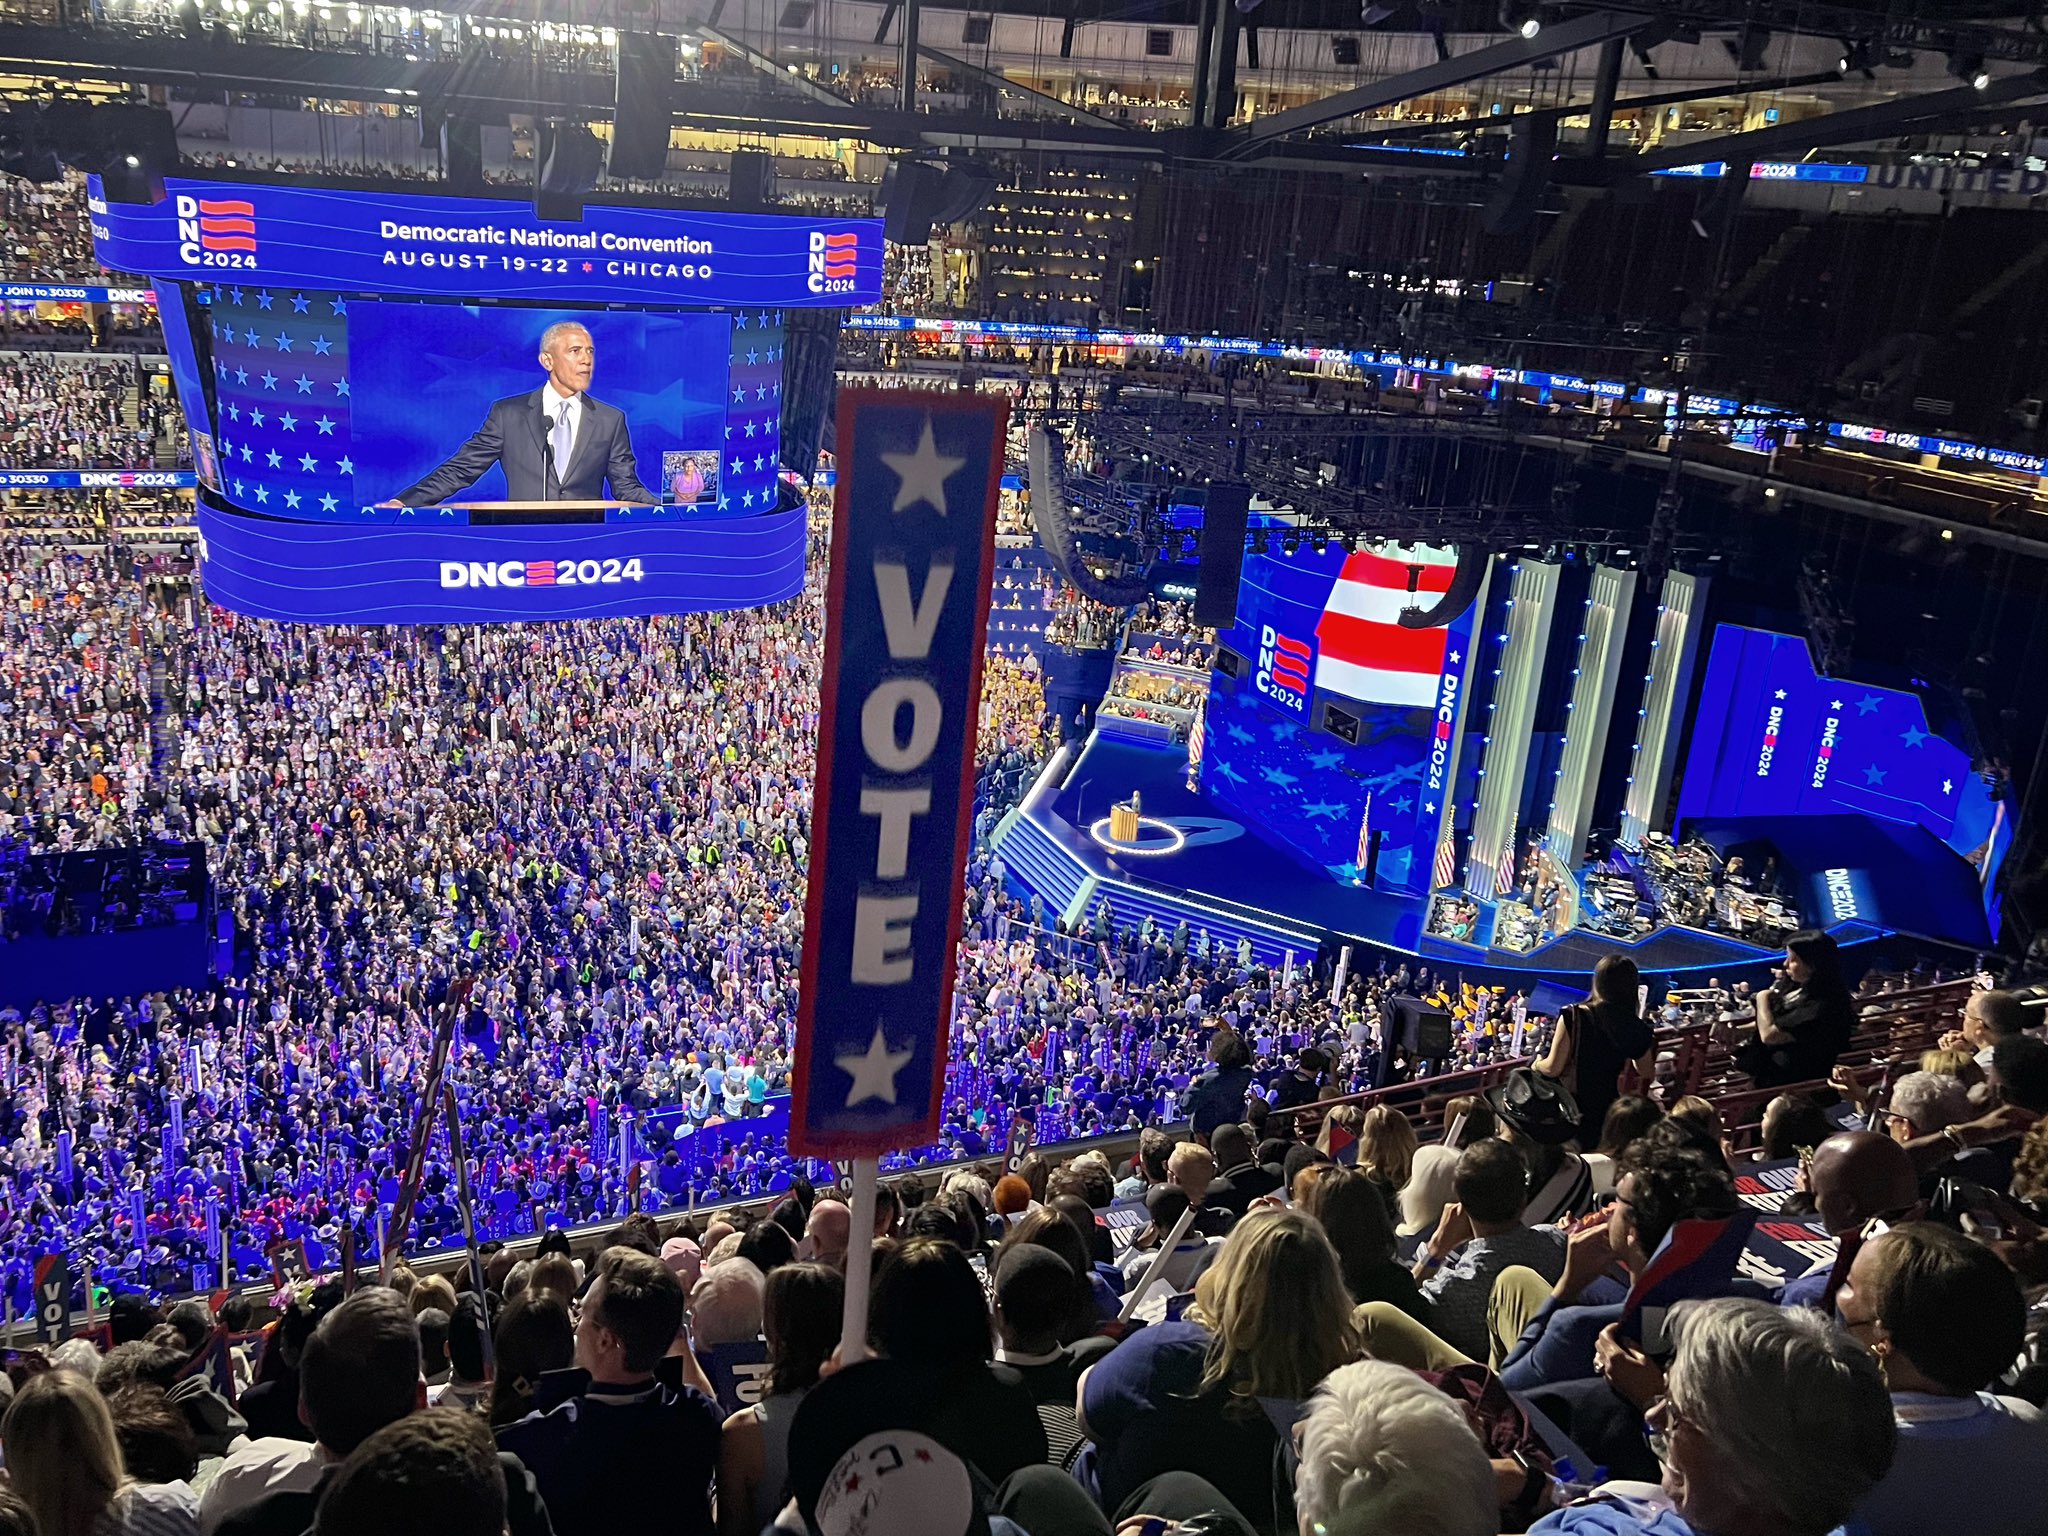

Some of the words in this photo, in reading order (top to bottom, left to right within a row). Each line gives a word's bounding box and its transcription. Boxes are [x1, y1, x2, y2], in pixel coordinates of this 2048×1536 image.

[1763, 165, 1797, 177] 2024
[176, 195, 200, 265] DNC
[380, 221, 506, 244] Democratic
[510, 228, 596, 248] National
[601, 232, 713, 254] Convention
[203, 252, 257, 269] 2024
[382, 250, 489, 269] AUGUST
[501, 256, 568, 273] 19-22
[606, 261, 713, 279] CHICAGO
[5, 287, 34, 296] JOIN
[35, 287, 47, 297] to
[49, 288, 87, 298] 30330
[107, 288, 145, 302] DNC
[824, 279, 855, 292] 2024
[8, 474, 49, 485] 30330
[80, 472, 121, 486] DNC
[134, 472, 178, 486] 2024
[439, 560, 525, 588] DNC
[556, 558, 644, 585] 2024
[1162, 583, 1197, 597] DNC
[1269, 684, 1304, 712] 2024
[1438, 673, 1459, 723] DNC
[1766, 705, 1783, 736] DNC
[1821, 717, 1839, 747] DNC
[851, 562, 954, 985] VOTE
[1427, 739, 1447, 790] 2024
[1756, 745, 1774, 777] 2024
[1812, 757, 1829, 789] 2024
[1824, 868, 1851, 891] DNC
[1832, 898, 1858, 921] 202
[1475, 999, 1485, 1031] IDAHO
[985, 1085, 993, 1106] VOTE
[989, 1134, 997, 1153] VOT
[1008, 1141, 1026, 1172] VO
[483, 1166, 492, 1190] VOTE
[837, 1159, 854, 1191] VO
[1105, 1209, 1144, 1228] OUR
[44, 1282, 63, 1341] VOT
